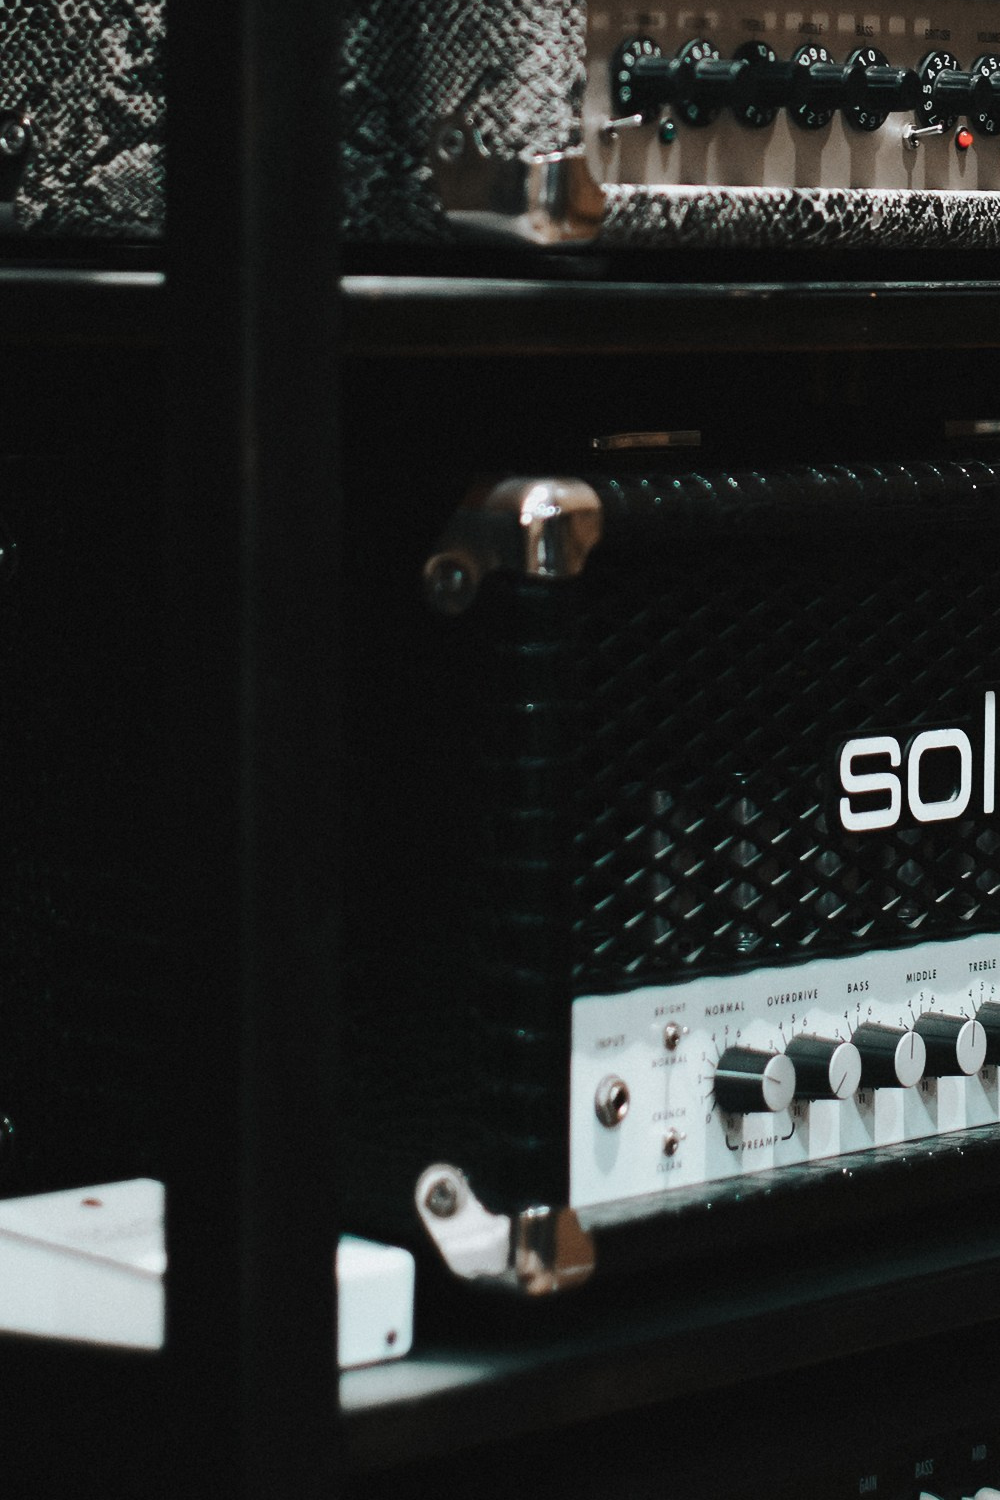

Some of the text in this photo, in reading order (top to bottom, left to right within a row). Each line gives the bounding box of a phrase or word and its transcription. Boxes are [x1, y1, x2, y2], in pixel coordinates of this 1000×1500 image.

[934, 57, 943, 68] 3
[943, 54, 950, 66] 2
[705, 1001, 745, 1017] NORMAL
[767, 989, 818, 1007] OVERDRIVE
[847, 980, 870, 994] BASS
[906, 969, 937, 983] MIDDLE
[969, 959, 997, 973] TREBLE
[655, 1003, 686, 1018] BRIGHT
[741, 1136, 779, 1151] PREAMP
[915, 1459, 934, 1479] BASS
